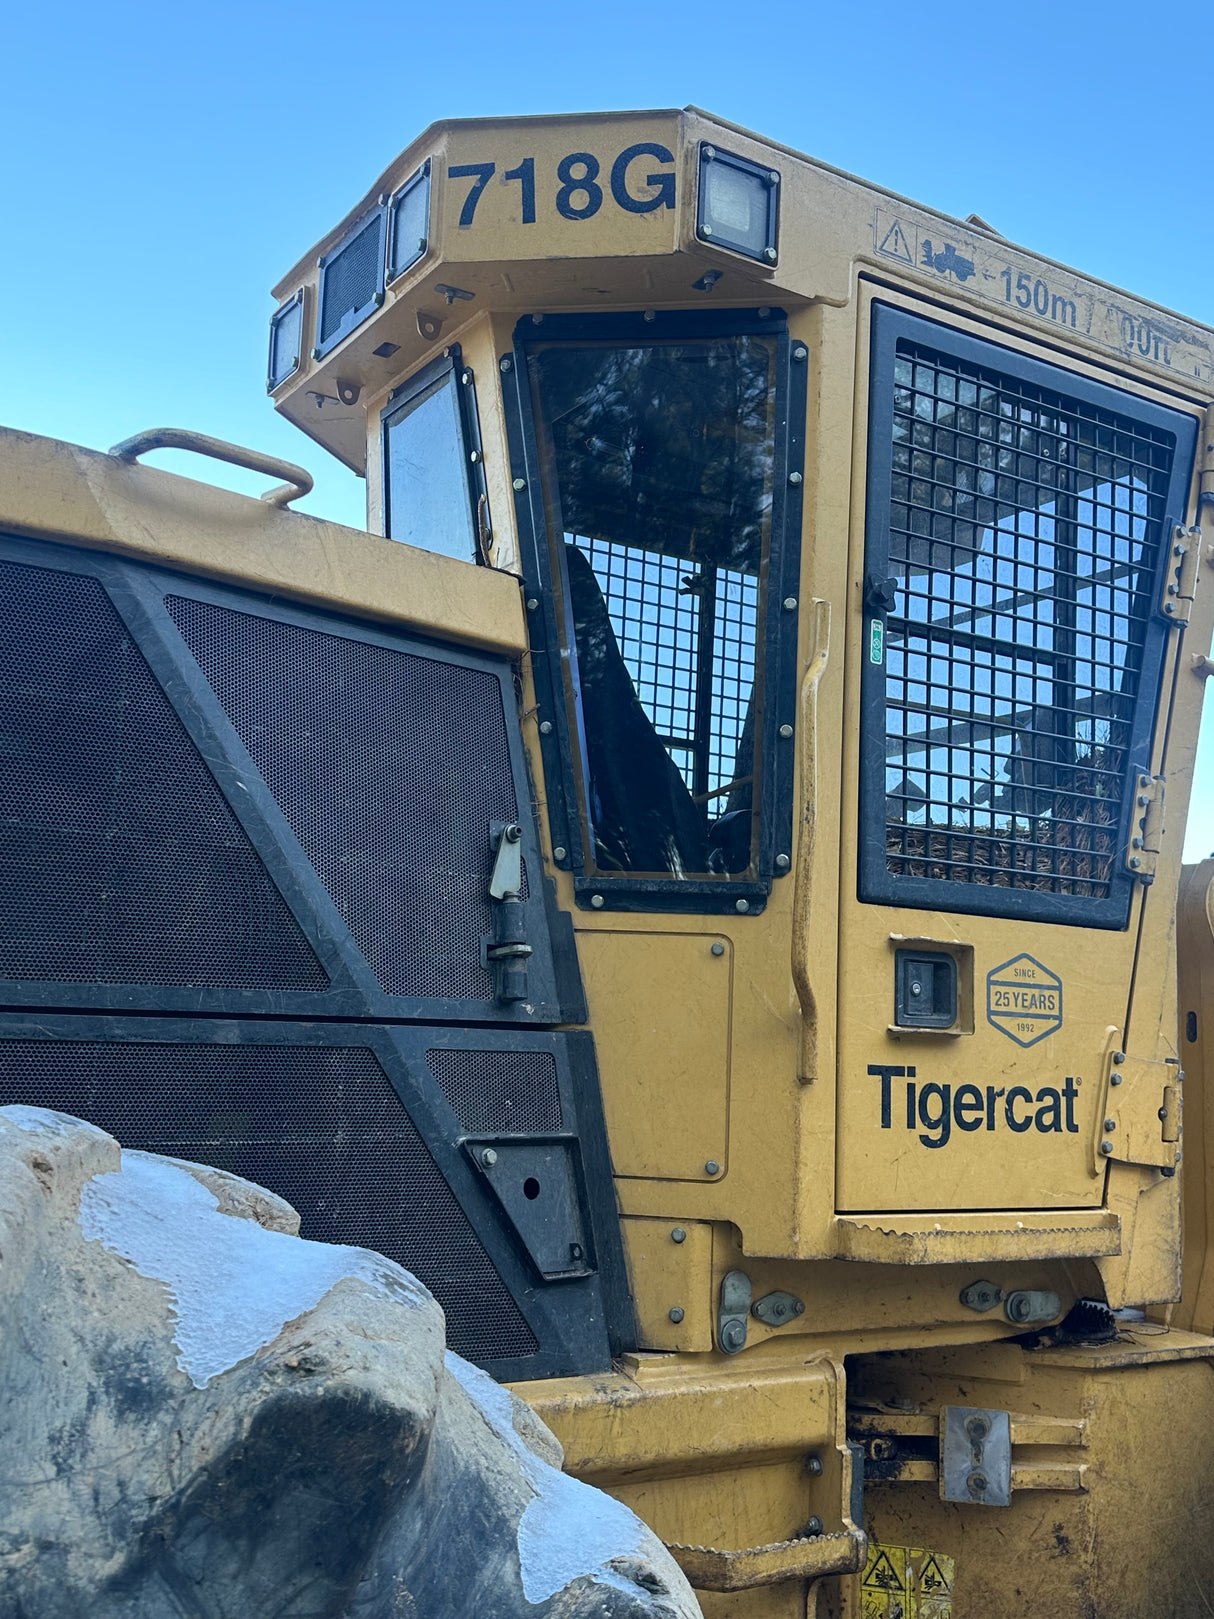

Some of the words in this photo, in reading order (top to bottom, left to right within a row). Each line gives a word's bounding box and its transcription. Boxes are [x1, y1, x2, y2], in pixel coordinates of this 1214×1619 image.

[448, 142, 676, 230] 718G
[1001, 266, 1077, 328] 150m
[1013, 967, 1036, 979] SINCE
[994, 990, 1010, 1007] 25
[1012, 991, 1055, 1011] YEARS
[1016, 1023, 1035, 1033] 1992
